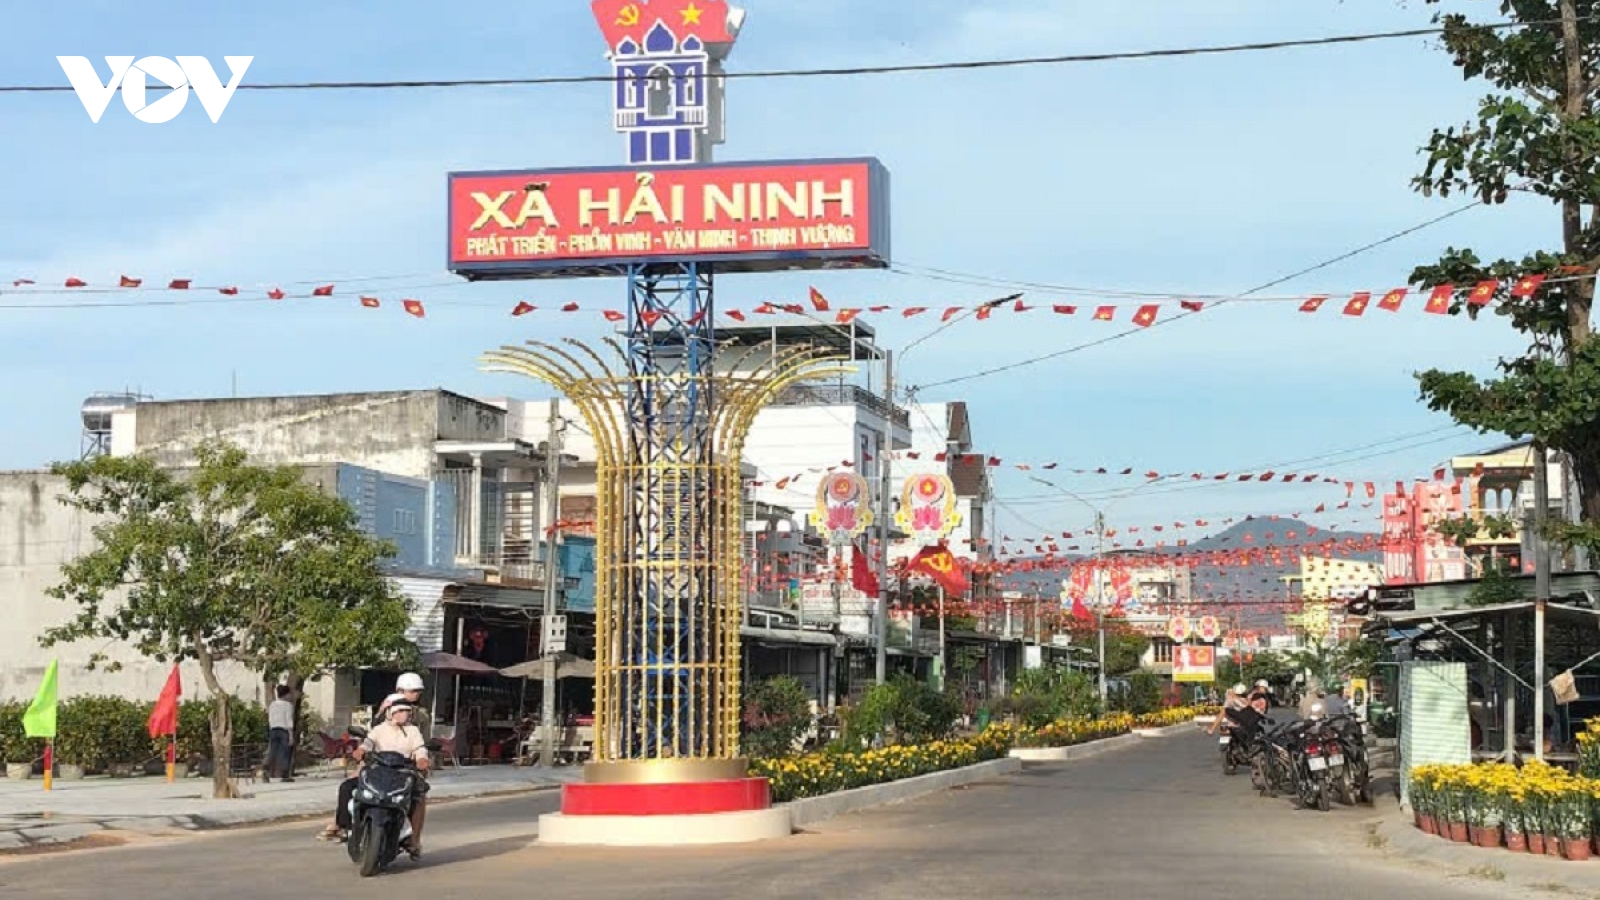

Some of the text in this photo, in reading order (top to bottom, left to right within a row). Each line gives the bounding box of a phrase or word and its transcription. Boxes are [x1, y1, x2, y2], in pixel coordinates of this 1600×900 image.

[470, 172, 853, 230] XÃ HẢI NINH
[467, 233, 508, 256] PHÁT
[615, 231, 652, 251] VINH
[698, 229, 737, 248] MINH
[751, 226, 797, 250] THỊNH
